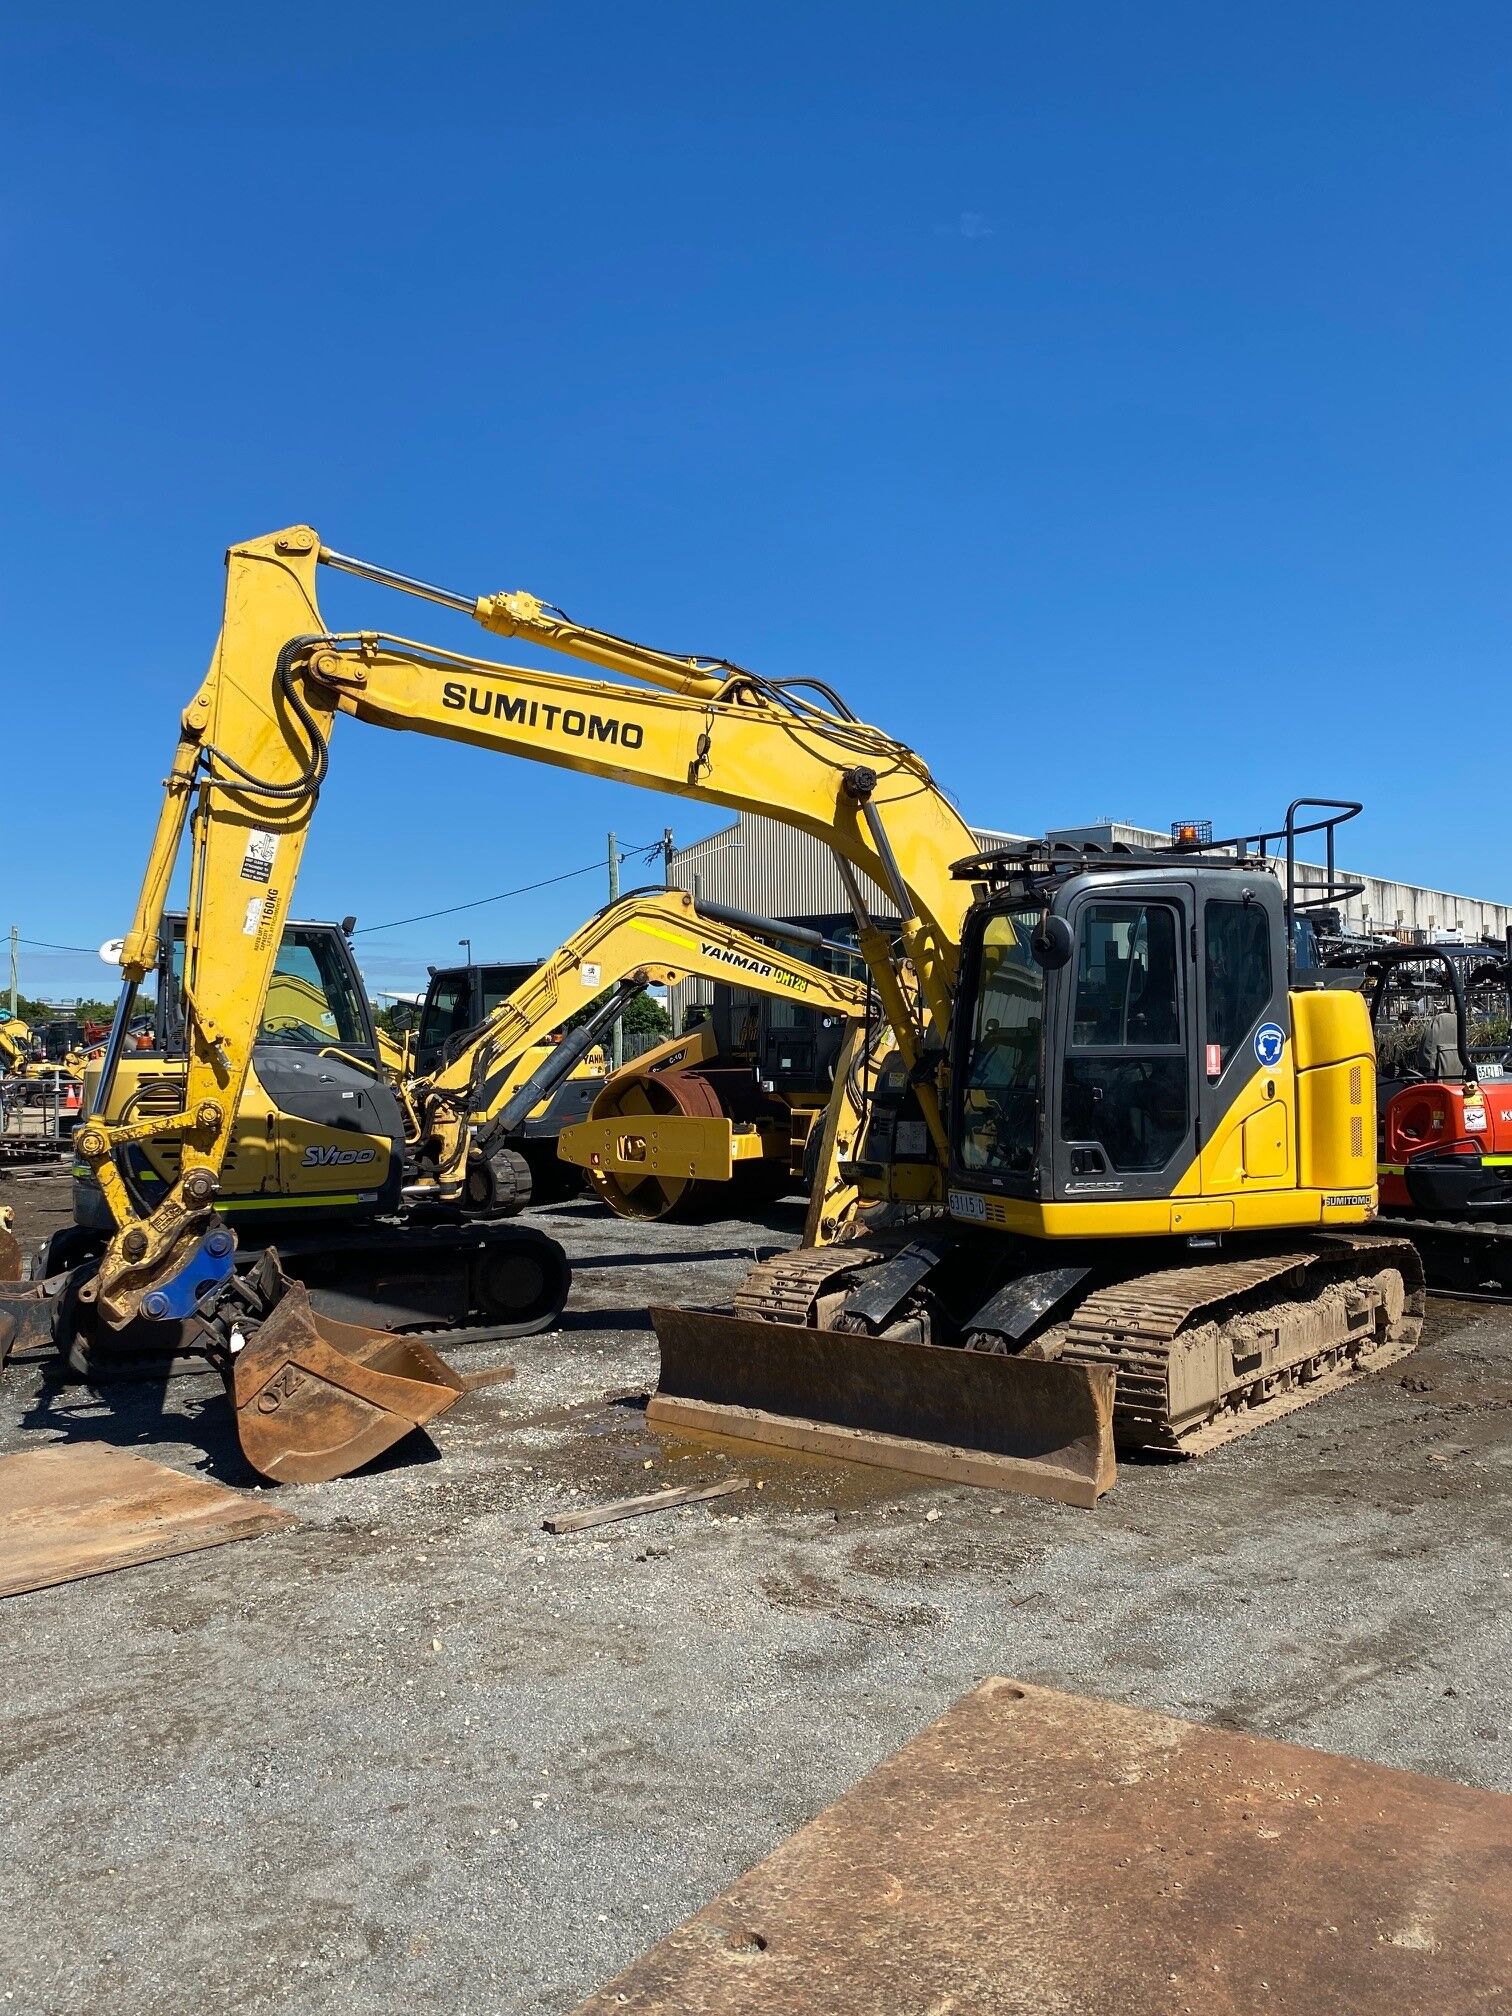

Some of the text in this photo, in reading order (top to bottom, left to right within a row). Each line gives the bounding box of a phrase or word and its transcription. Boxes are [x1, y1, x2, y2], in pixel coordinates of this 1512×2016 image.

[442, 682, 644, 750] SUMITOMO
[701, 943, 772, 976] YANMAR
[301, 1145, 375, 1167] SV100
[1325, 1196, 1371, 1206] SUMITOMO
